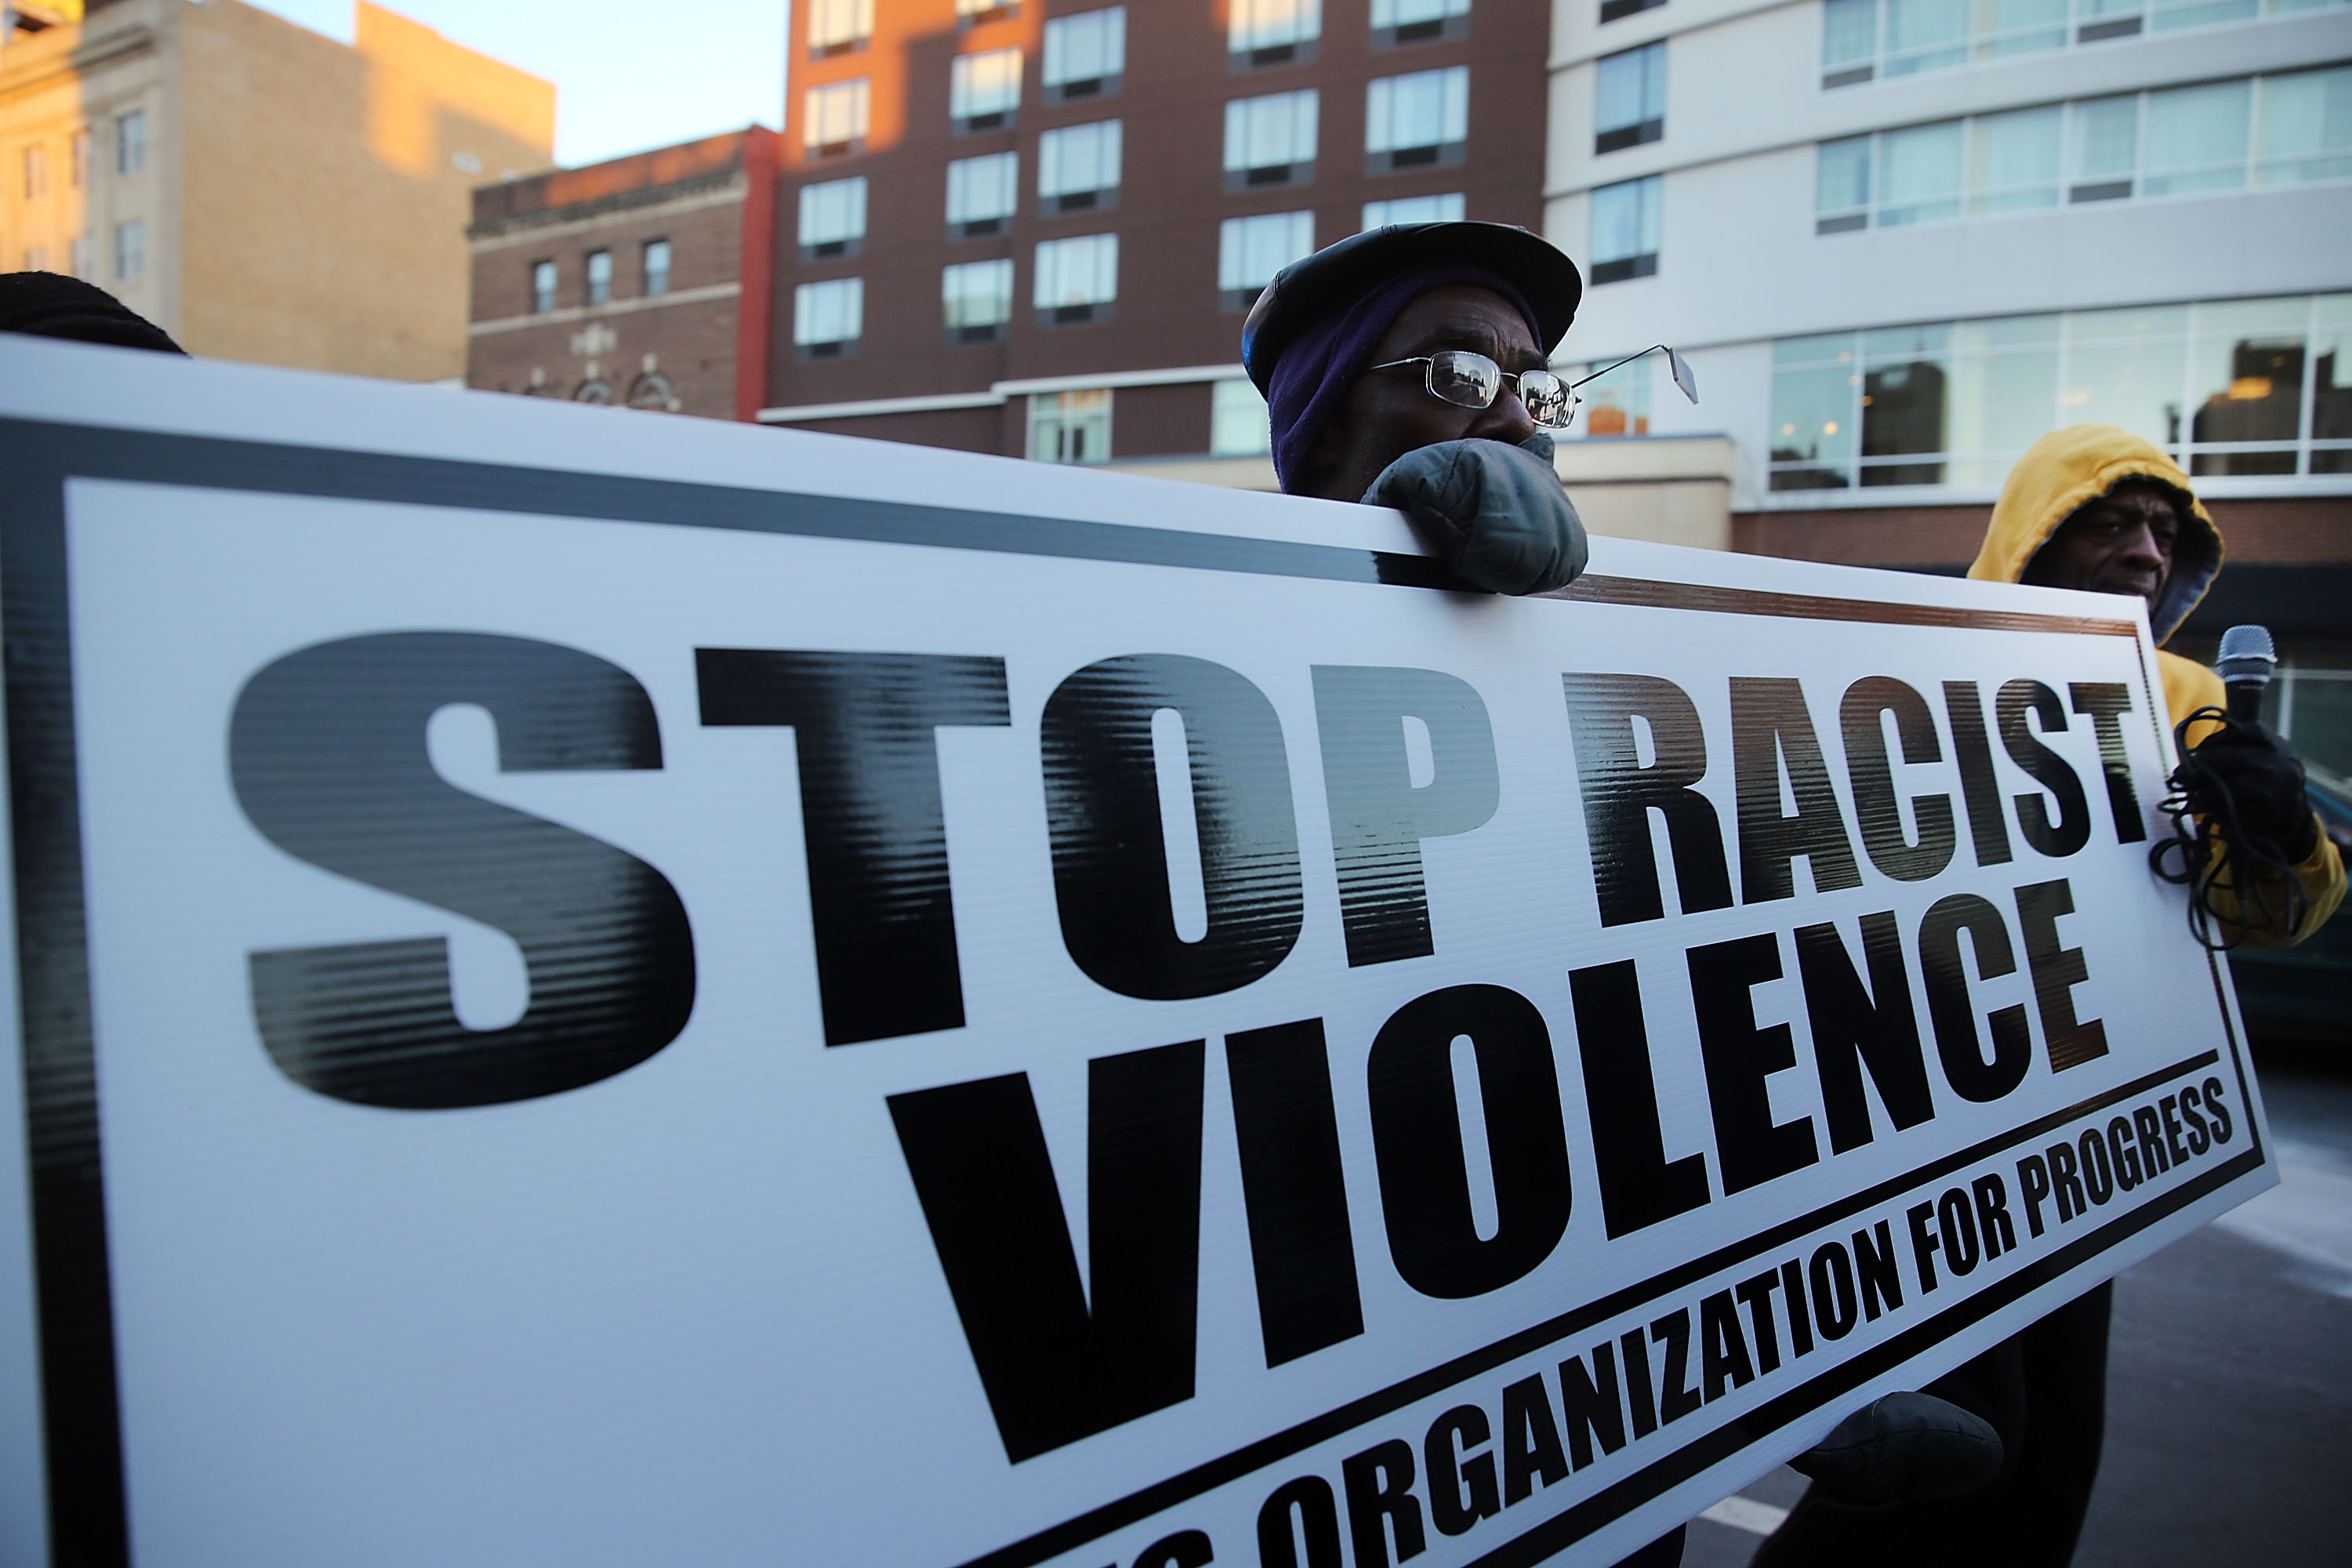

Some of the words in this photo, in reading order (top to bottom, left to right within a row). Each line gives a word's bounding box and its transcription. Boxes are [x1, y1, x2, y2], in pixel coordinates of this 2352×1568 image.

[227, 629, 1501, 1112] STOP
[1561, 672, 2147, 928] RACIST
[886, 877, 2111, 1466] VIOLENCE
[1256, 1218, 1904, 1568] ORGANIZATION
[1906, 1173, 2018, 1297] FOR
[2016, 1076, 2233, 1240] PROGRESS
